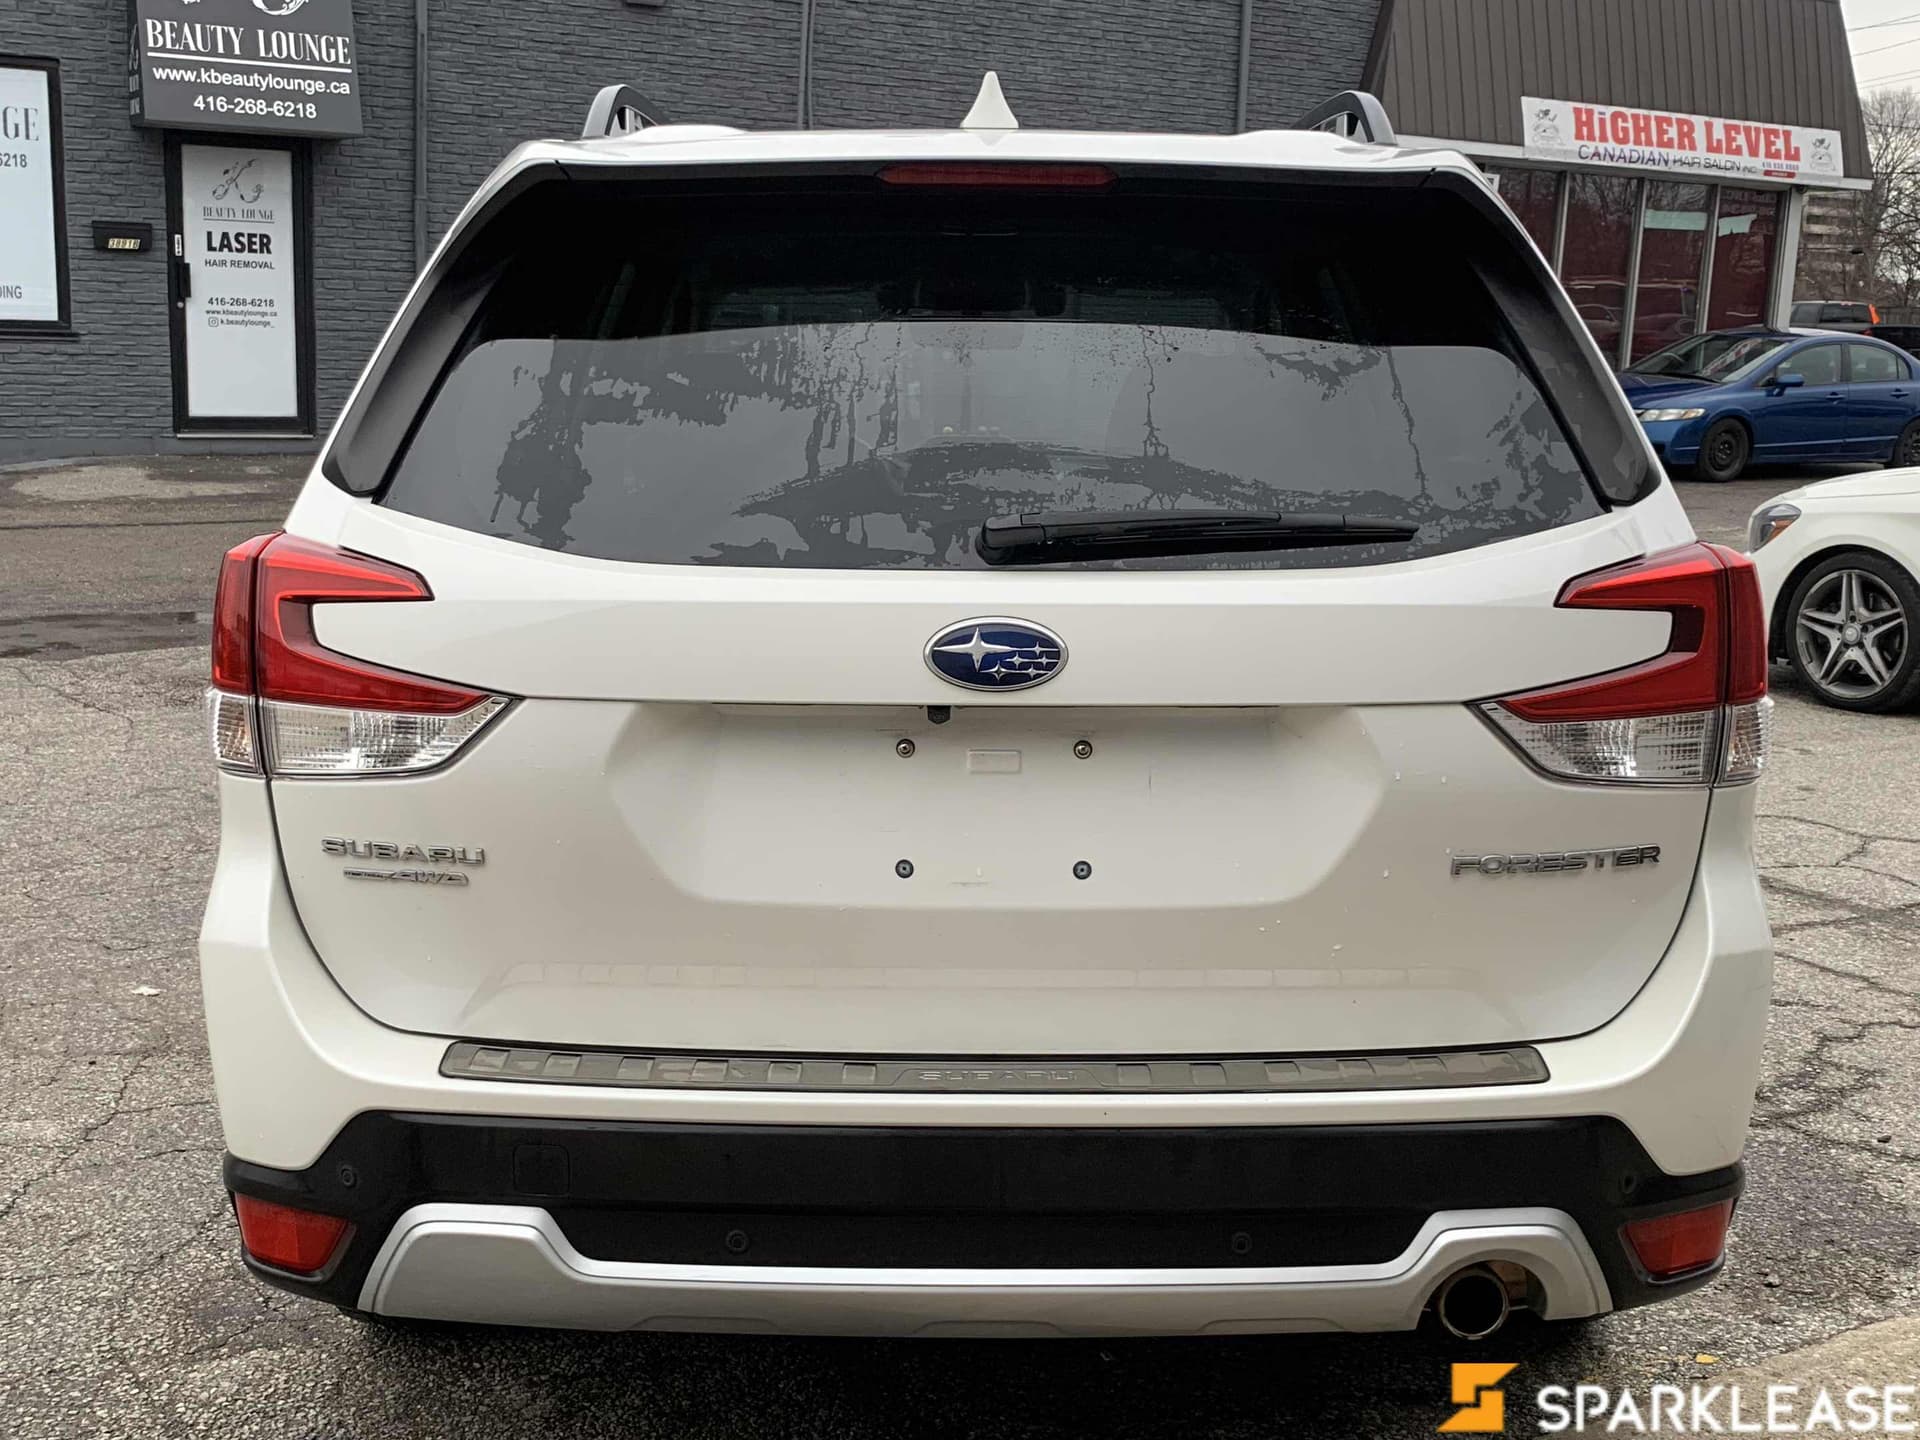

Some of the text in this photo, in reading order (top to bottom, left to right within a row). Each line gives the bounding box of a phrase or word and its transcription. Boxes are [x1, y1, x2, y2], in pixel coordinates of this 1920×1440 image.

[145, 18, 351, 64] BEAUTY LOUNGE
[152, 66, 351, 95] www.kbeautylounge.ca
[193, 95, 318, 119] 416-268-6218
[1704, 120, 1801, 162] LEVEL
[1577, 143, 1670, 167] CANADIAN
[1703, 157, 1741, 172] SALON
[203, 206, 236, 218] BEAUTY
[206, 230, 272, 254] LASER
[204, 259, 275, 269] HAIR REMOVAL
[208, 297, 275, 308] 416-268-6218
[321, 836, 486, 866] SUBARU
[1451, 843, 1661, 876] FORESTER
